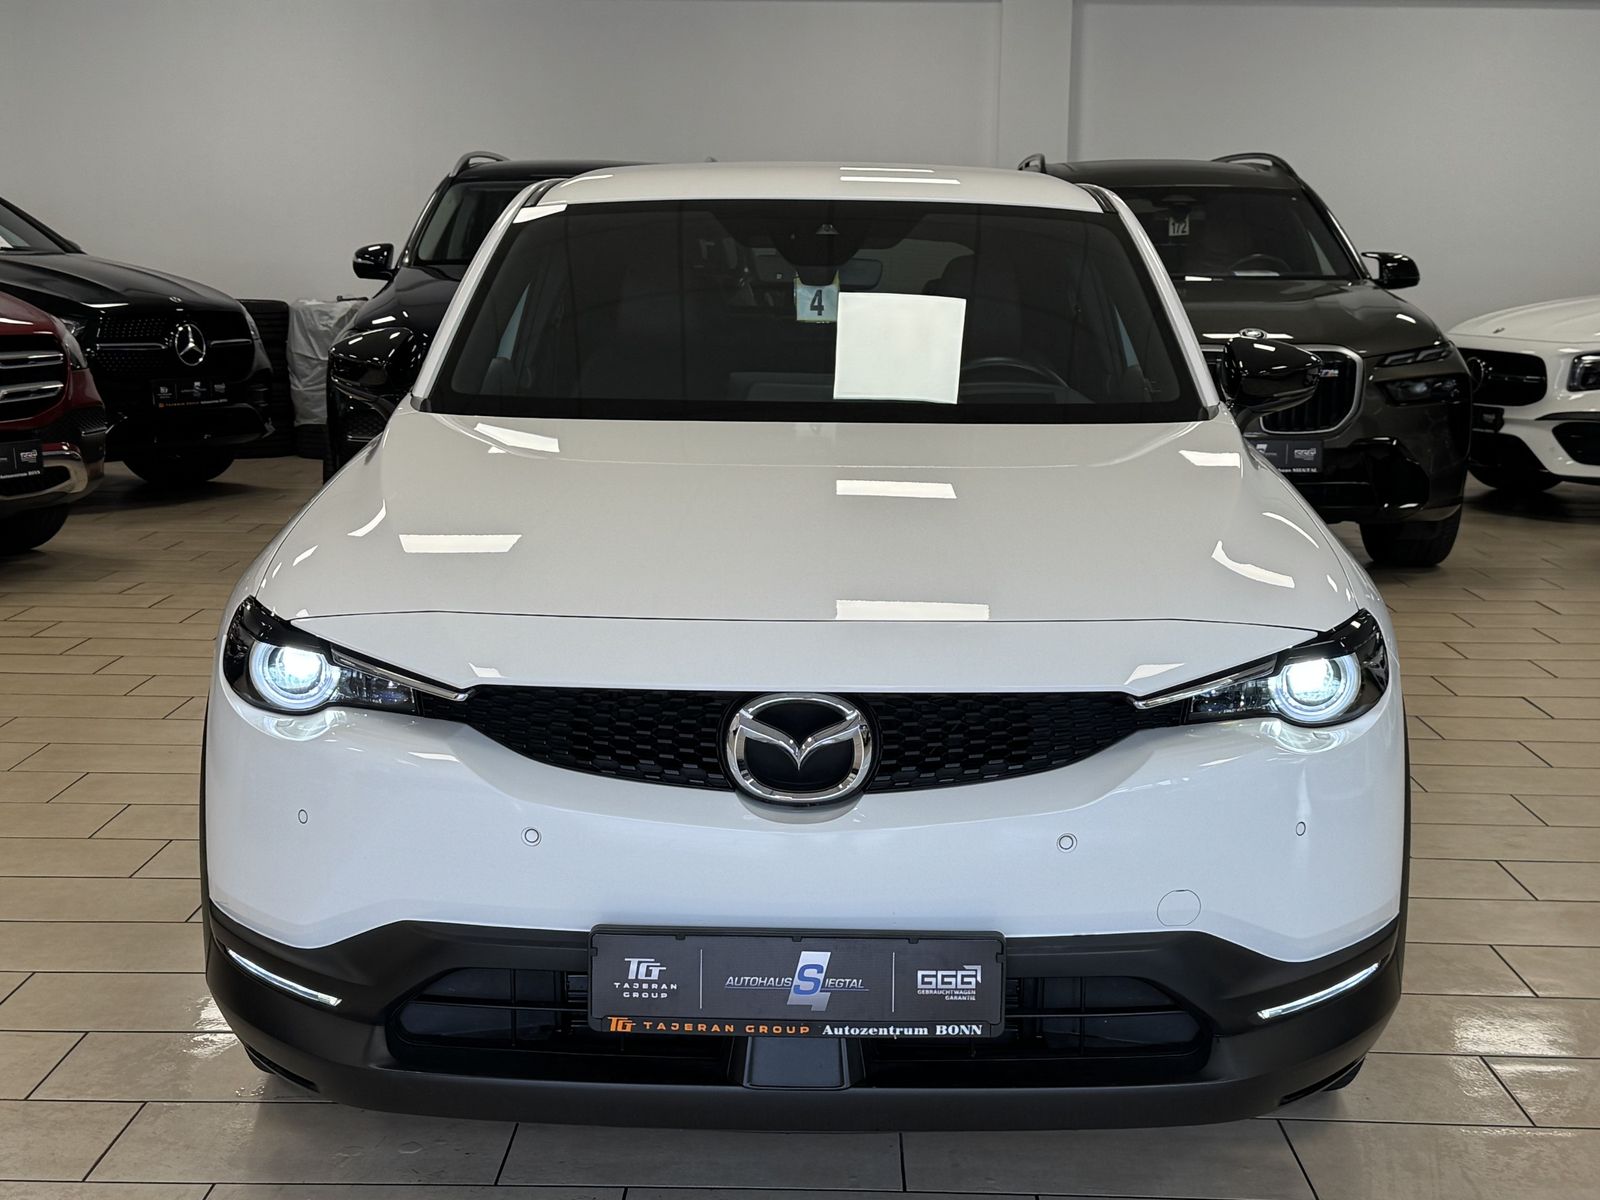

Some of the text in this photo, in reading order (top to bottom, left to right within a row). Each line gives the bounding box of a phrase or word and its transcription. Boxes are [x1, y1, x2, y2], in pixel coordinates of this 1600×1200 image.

[809, 289, 825, 316] 4
[613, 982, 678, 990] TAJERAN
[725, 976, 793, 987] AUTOHAUS
[917, 970, 976, 989] GGG
[643, 1021, 734, 1034] TAJERAN
[745, 1023, 811, 1034] GROUP
[821, 1024, 929, 1036] Autozentrum
[935, 1024, 983, 1036] BONN
